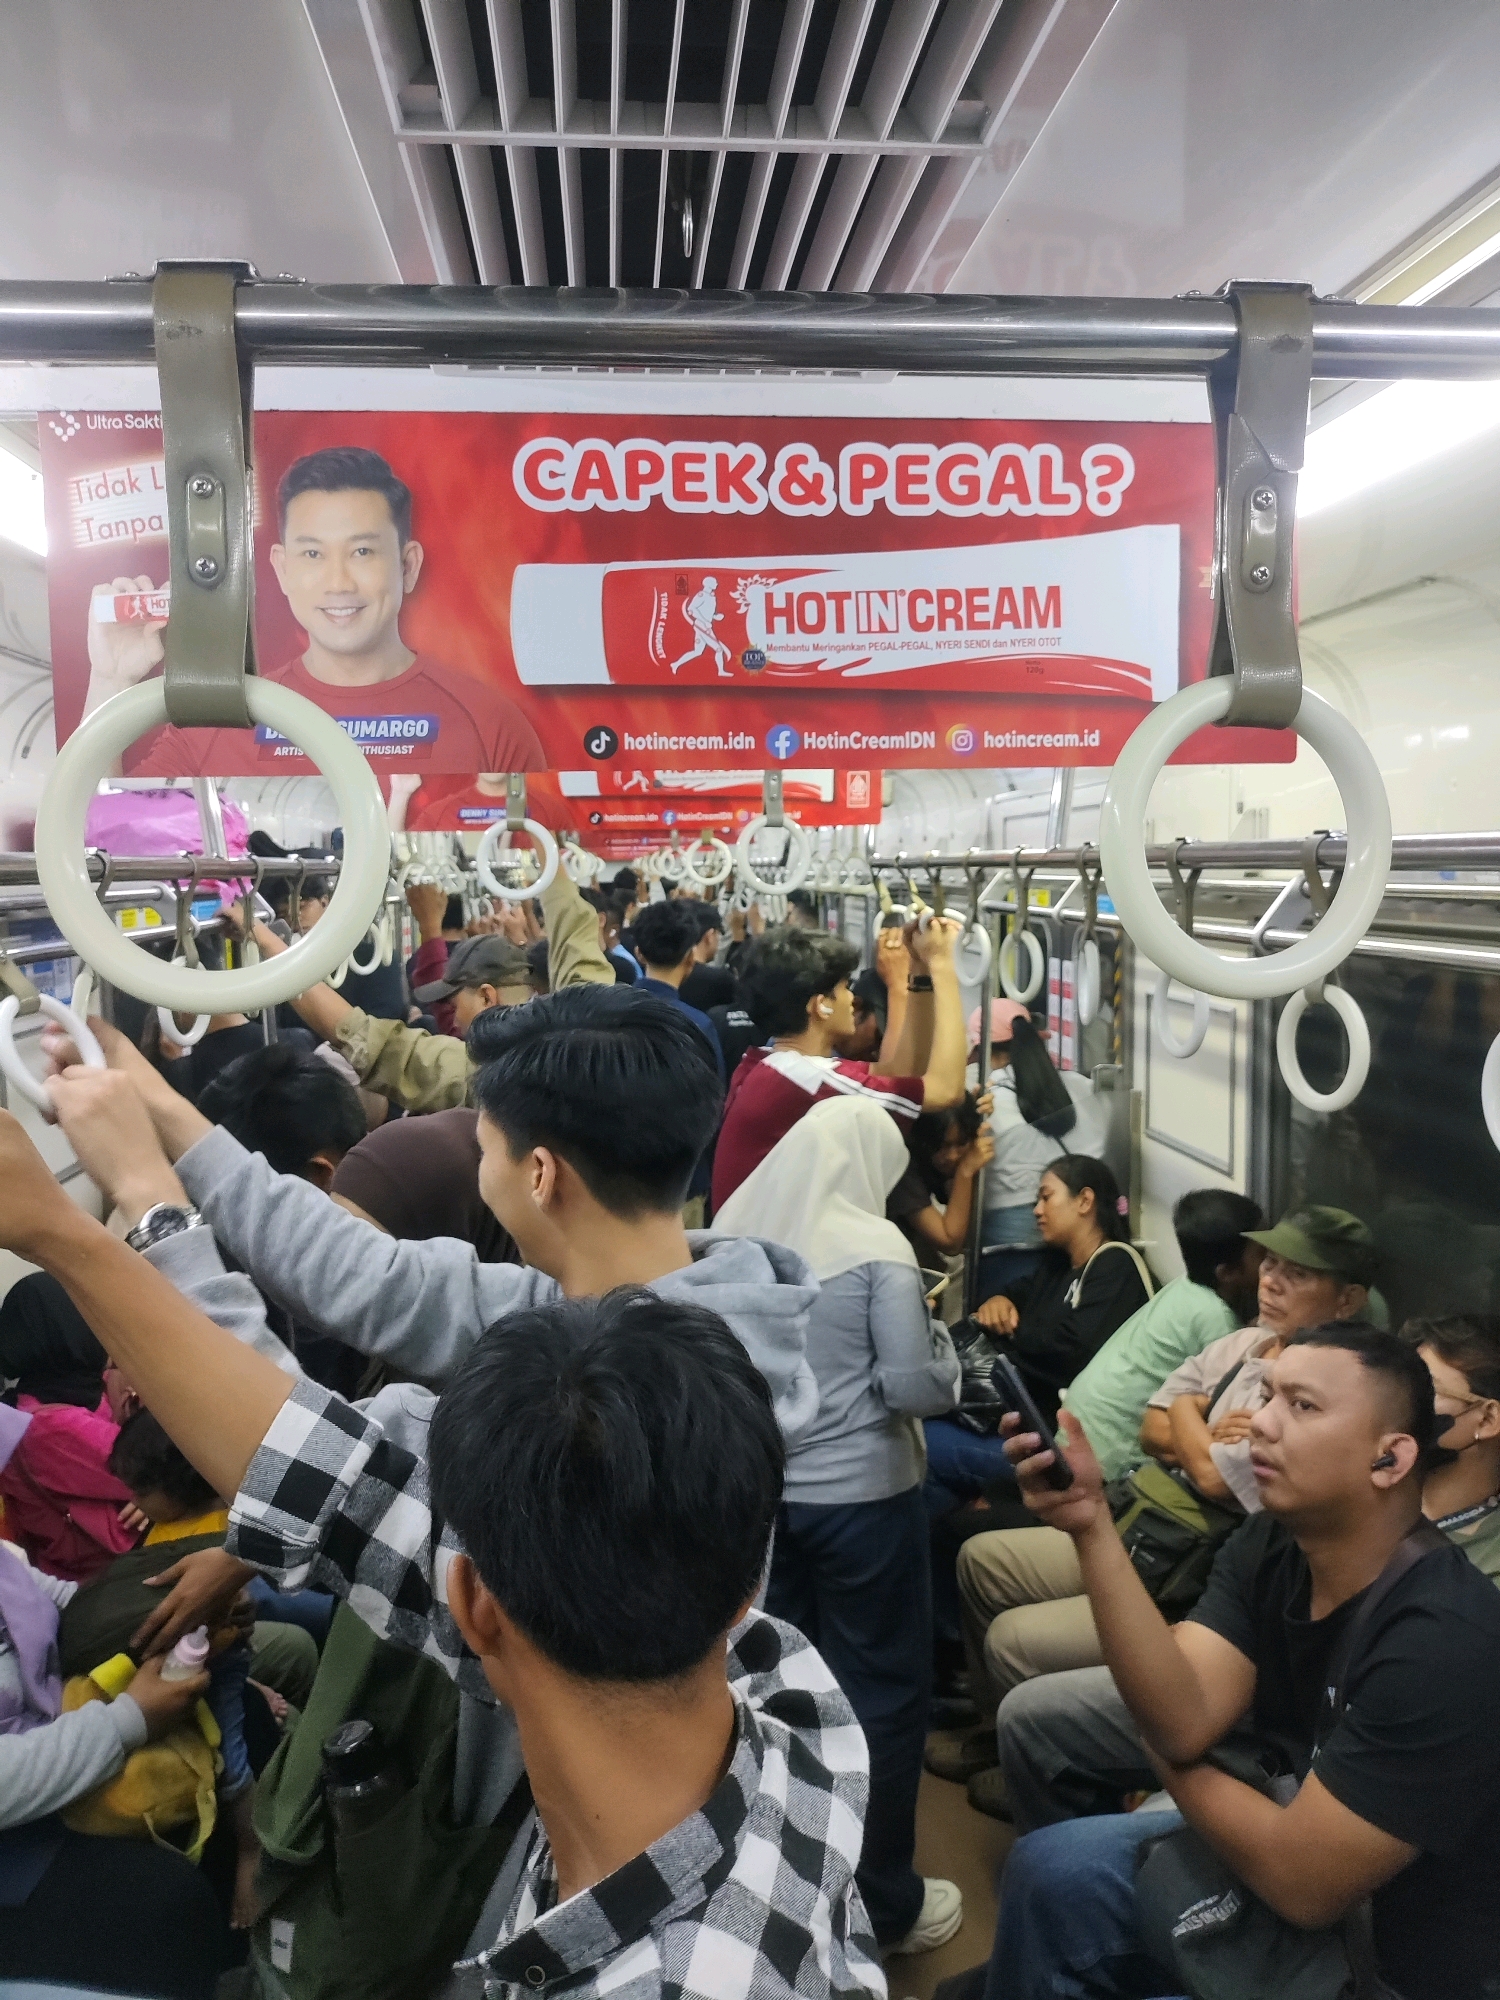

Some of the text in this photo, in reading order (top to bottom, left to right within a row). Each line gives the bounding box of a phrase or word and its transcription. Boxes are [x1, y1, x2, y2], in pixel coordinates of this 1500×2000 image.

[86, 414, 122, 429] Ultra
[70, 466, 143, 504] Tidak
[516, 441, 764, 510] CAPEK
[773, 447, 832, 511] &
[81, 514, 164, 542] Tanpa
[908, 585, 1062, 632] CREAM
[766, 637, 1062, 654] Membantu Meringankan PEGAL-PEGAL, NYERI SENDI dan NYERI OTOT
[624, 732, 756, 750] hotincream.idn
[803, 731, 936, 750] HotinCreamIDN
[983, 729, 1100, 748] hotincream.id
[359, 745, 415, 755] NTHUSIAST
